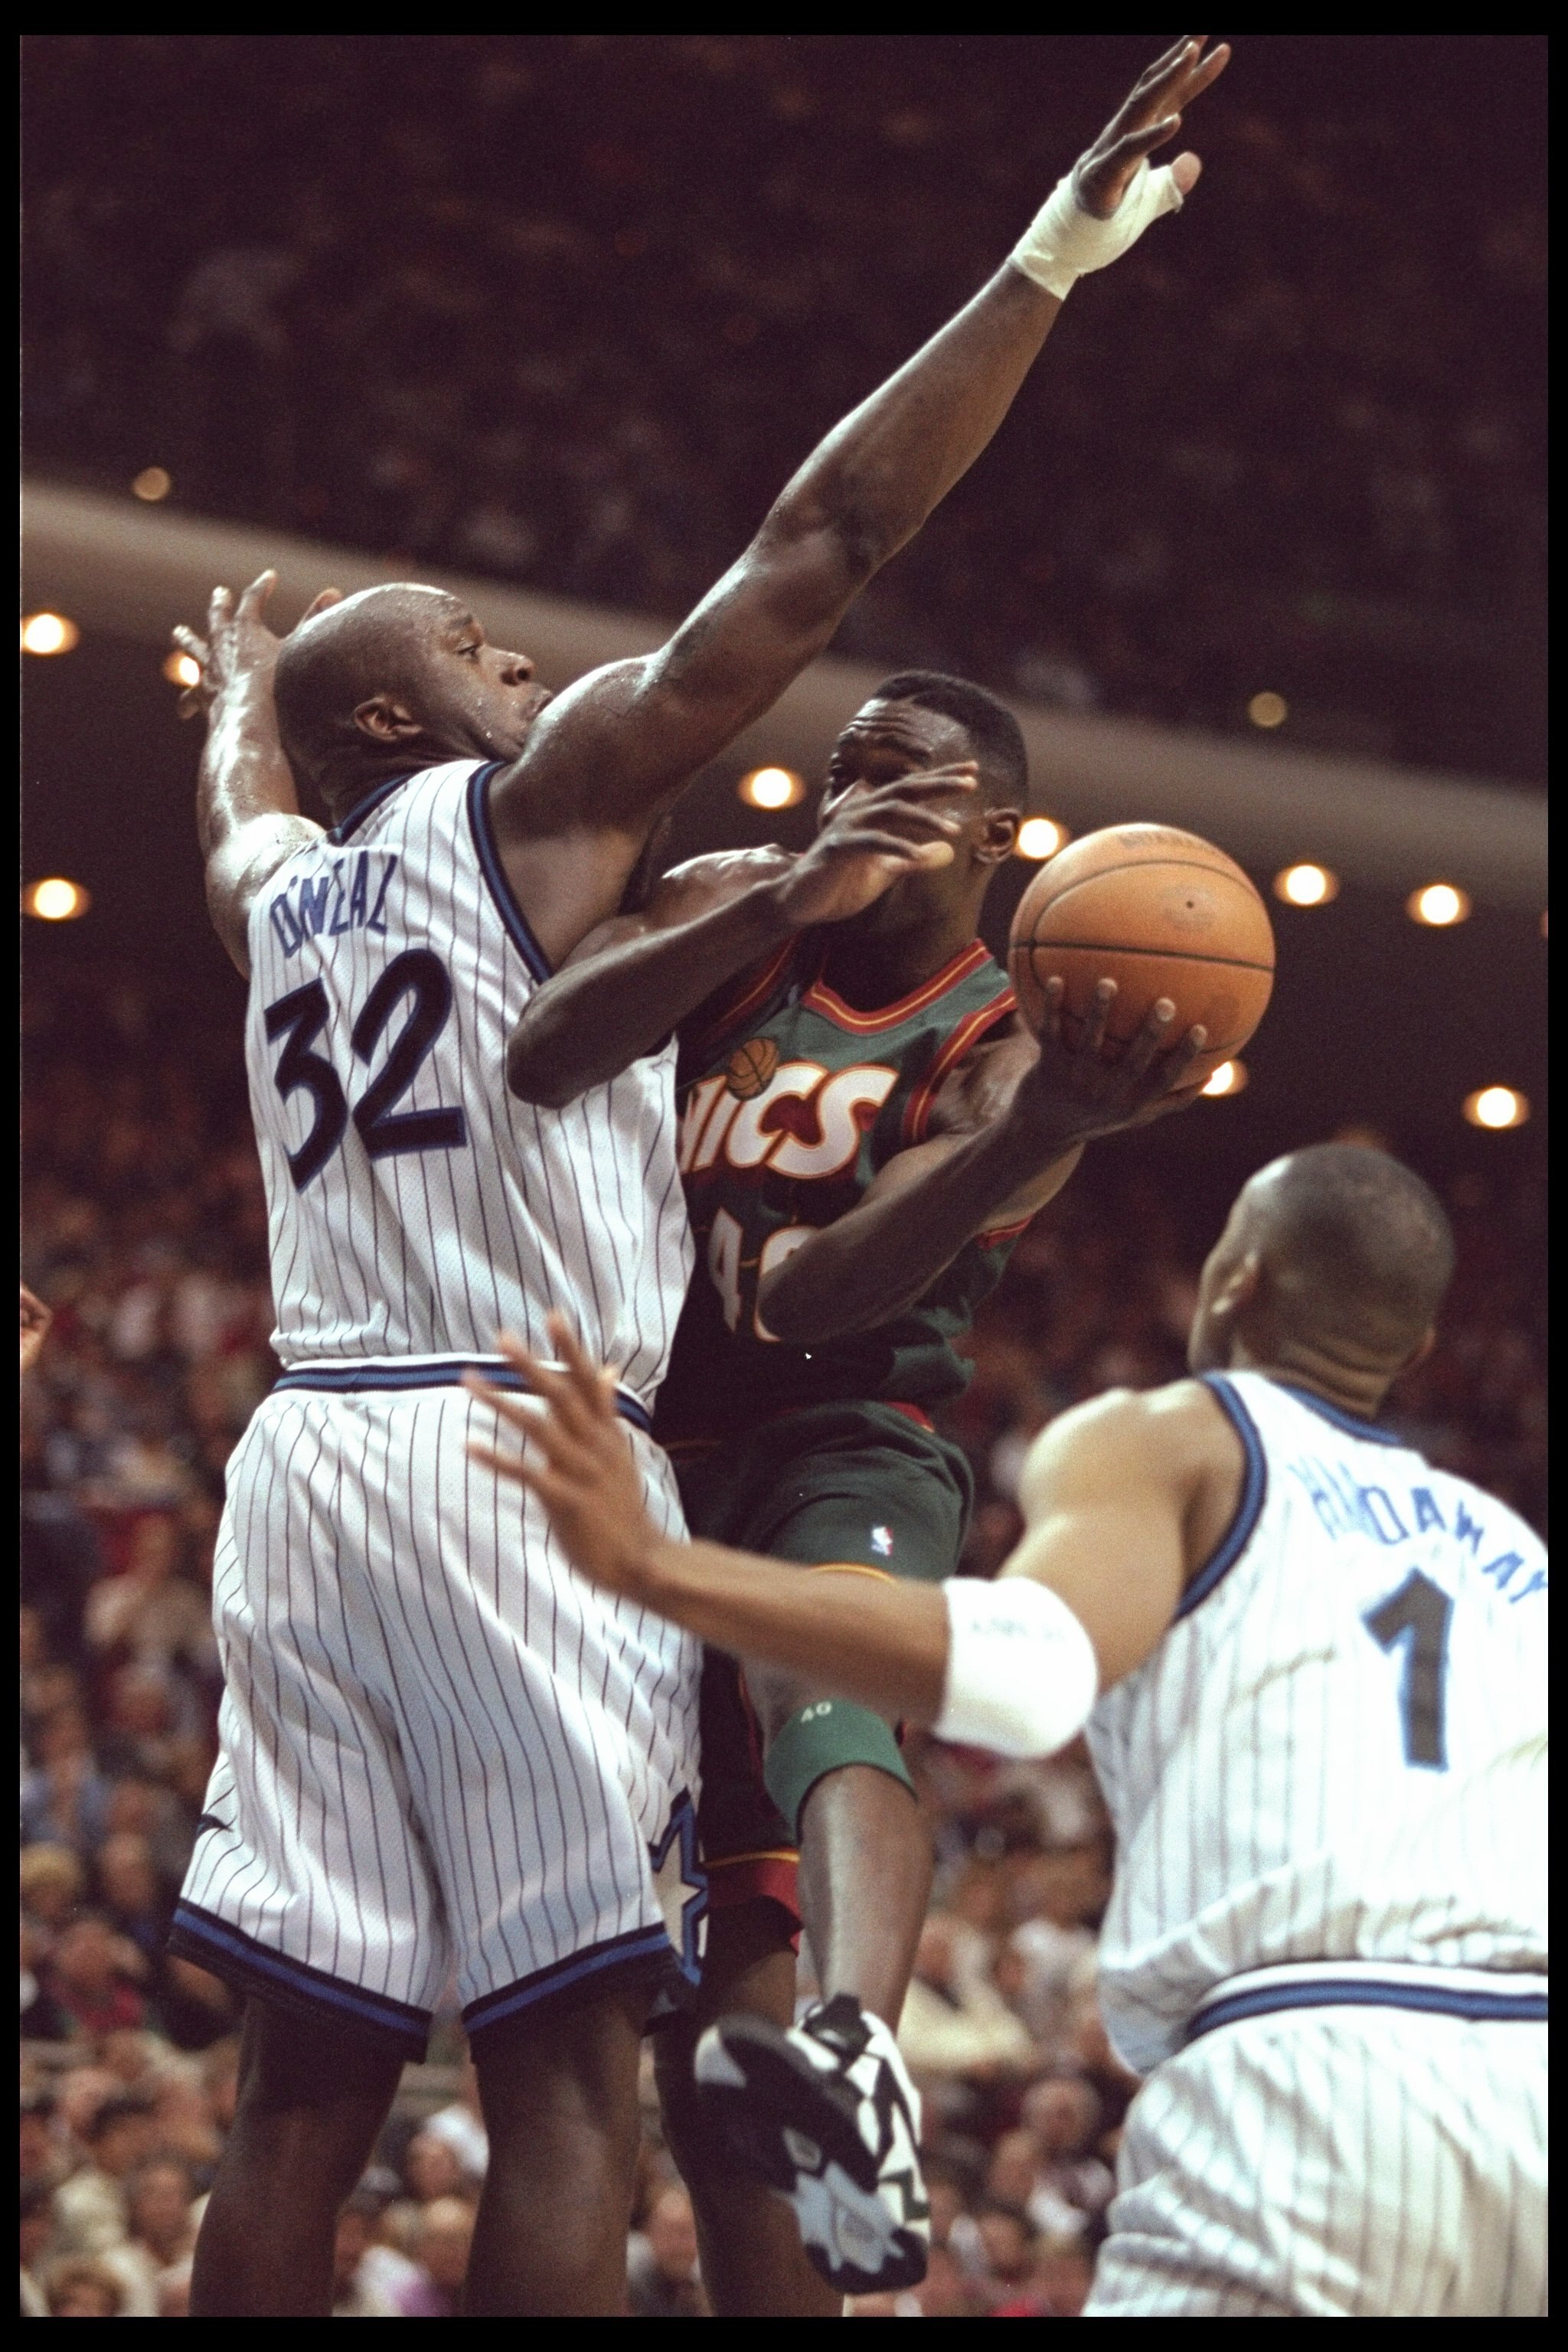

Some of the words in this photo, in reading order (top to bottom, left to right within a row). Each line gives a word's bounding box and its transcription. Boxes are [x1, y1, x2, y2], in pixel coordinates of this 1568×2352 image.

[263, 947, 468, 1195] 32
[801, 1701, 832, 1723] 40
[1360, 1565, 1455, 1775] 1
